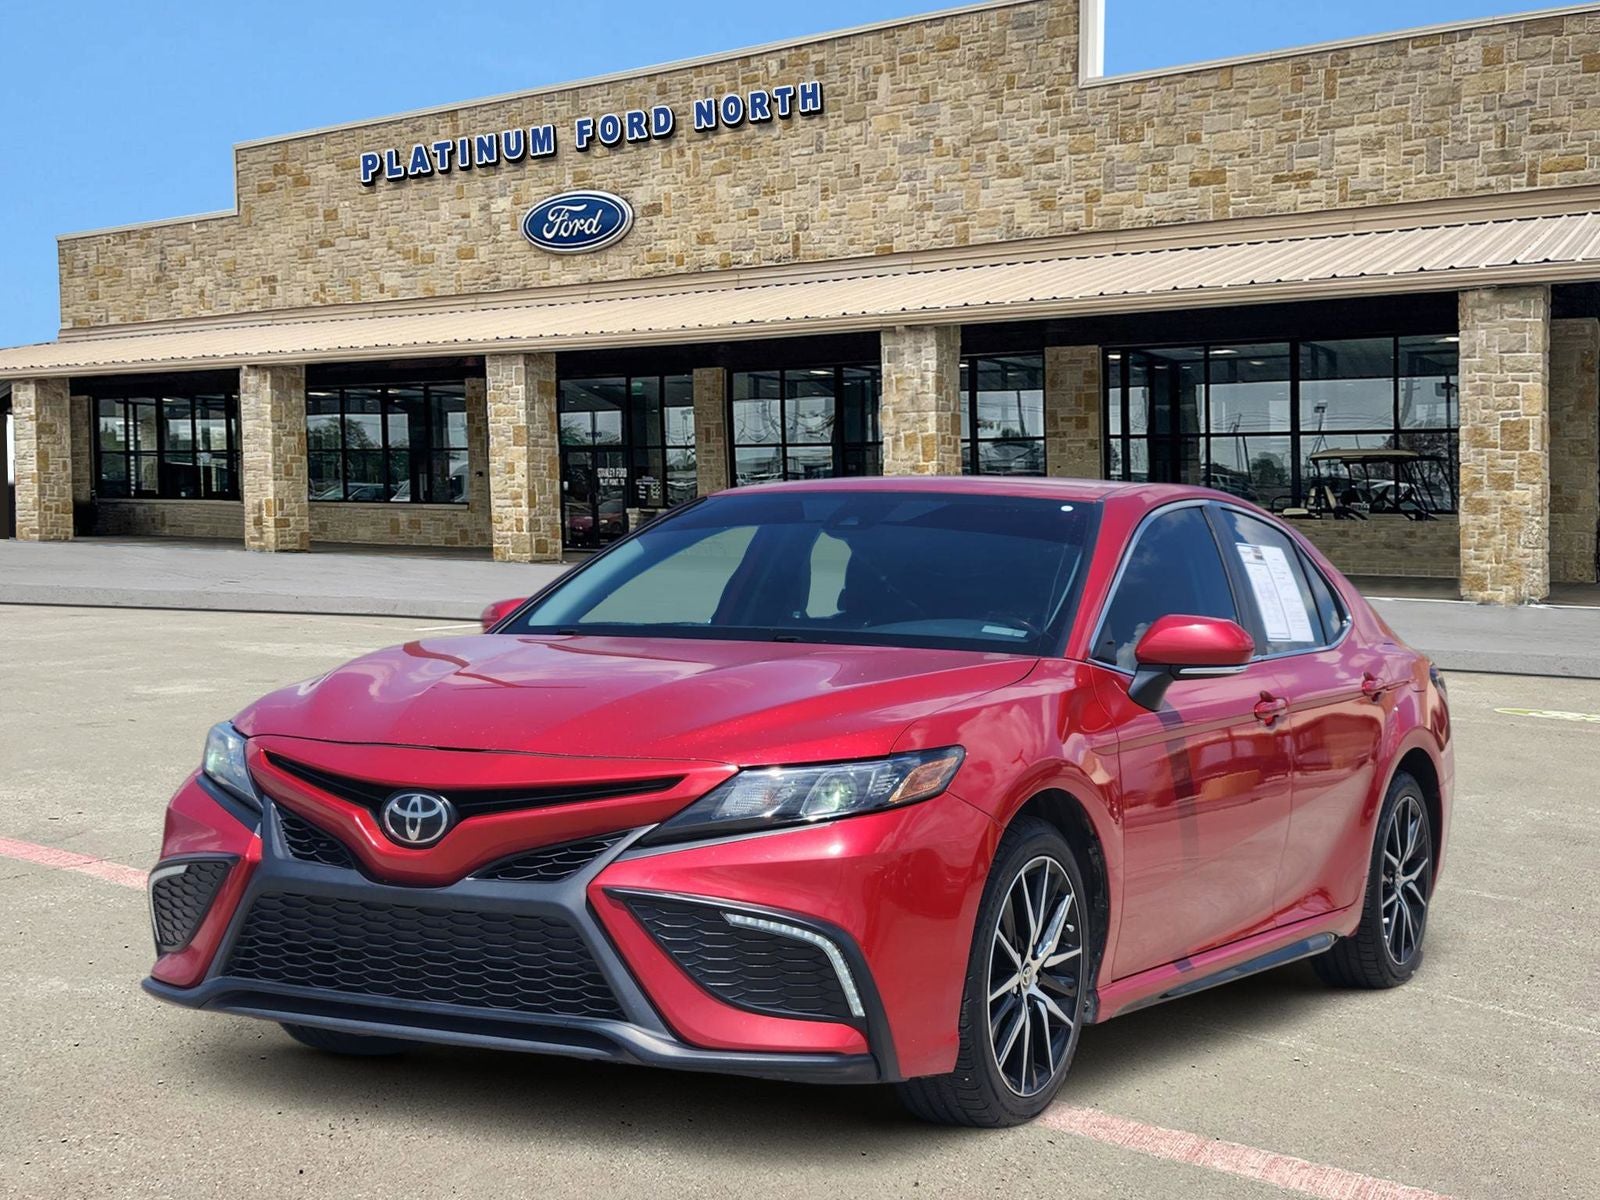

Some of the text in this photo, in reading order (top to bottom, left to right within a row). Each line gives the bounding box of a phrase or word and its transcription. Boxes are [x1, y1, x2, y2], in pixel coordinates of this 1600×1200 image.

[361, 81, 822, 184] PLATINUM FORD NORTH
[543, 204, 602, 239] Ford
